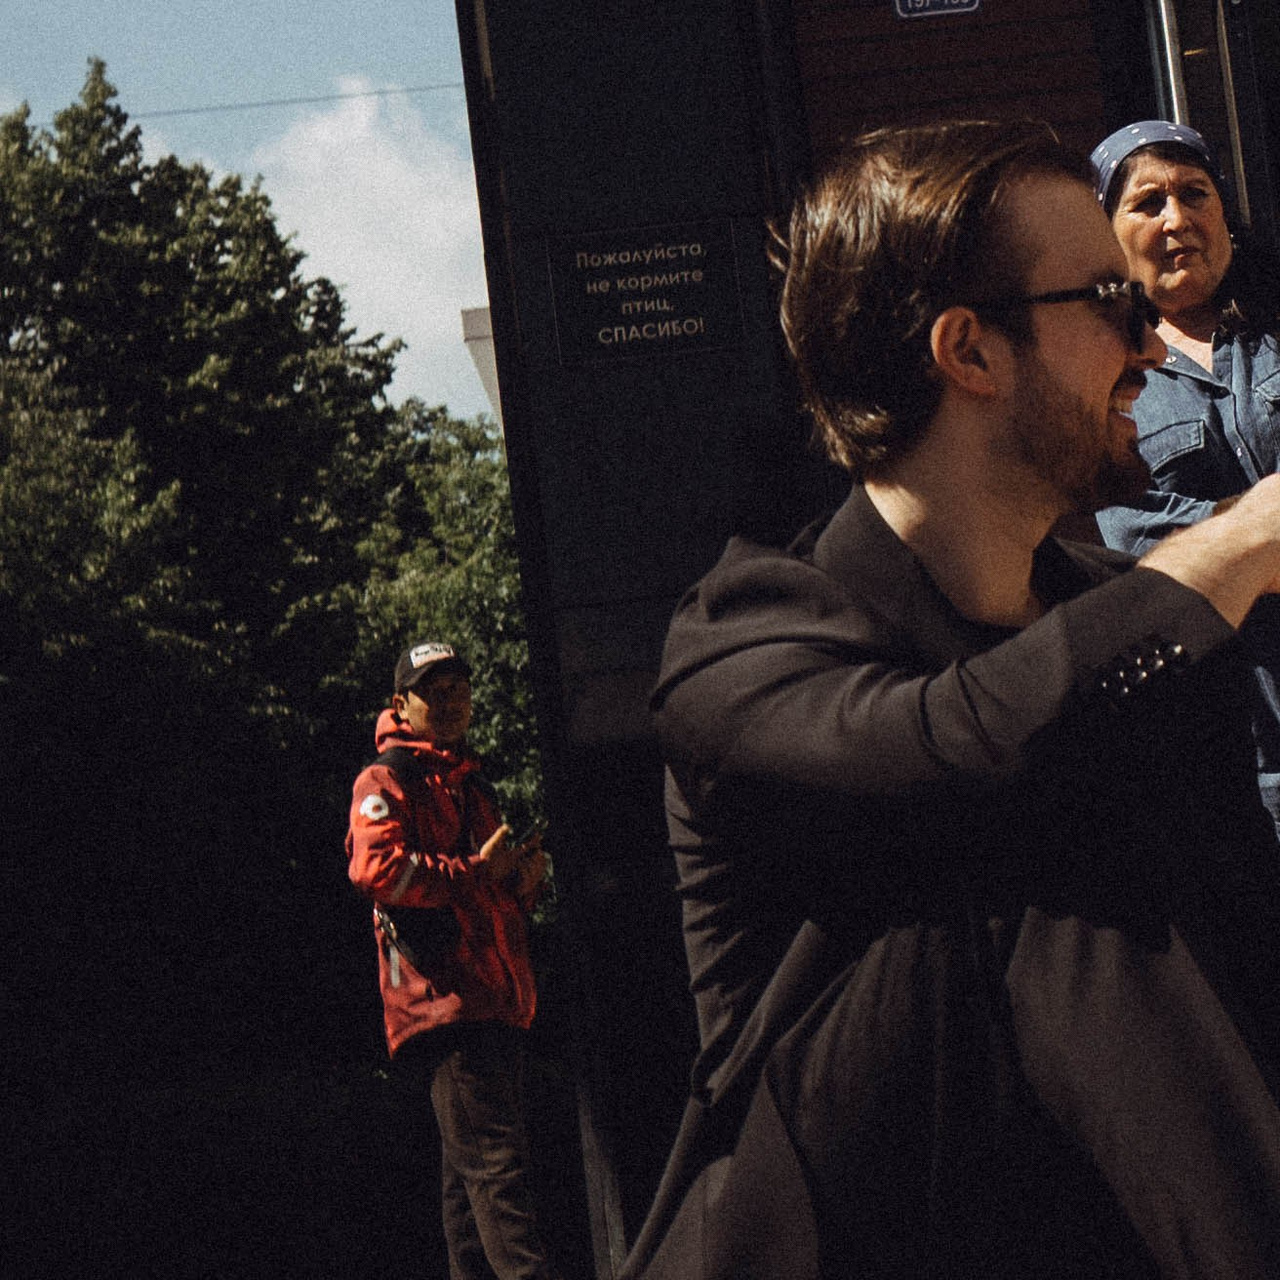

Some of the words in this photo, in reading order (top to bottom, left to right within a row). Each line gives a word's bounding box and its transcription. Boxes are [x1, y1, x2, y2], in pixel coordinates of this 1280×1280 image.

[586, 280, 610, 294] не
[617, 269, 703, 291] кормите
[598, 317, 705, 344] СПАСИБО!
